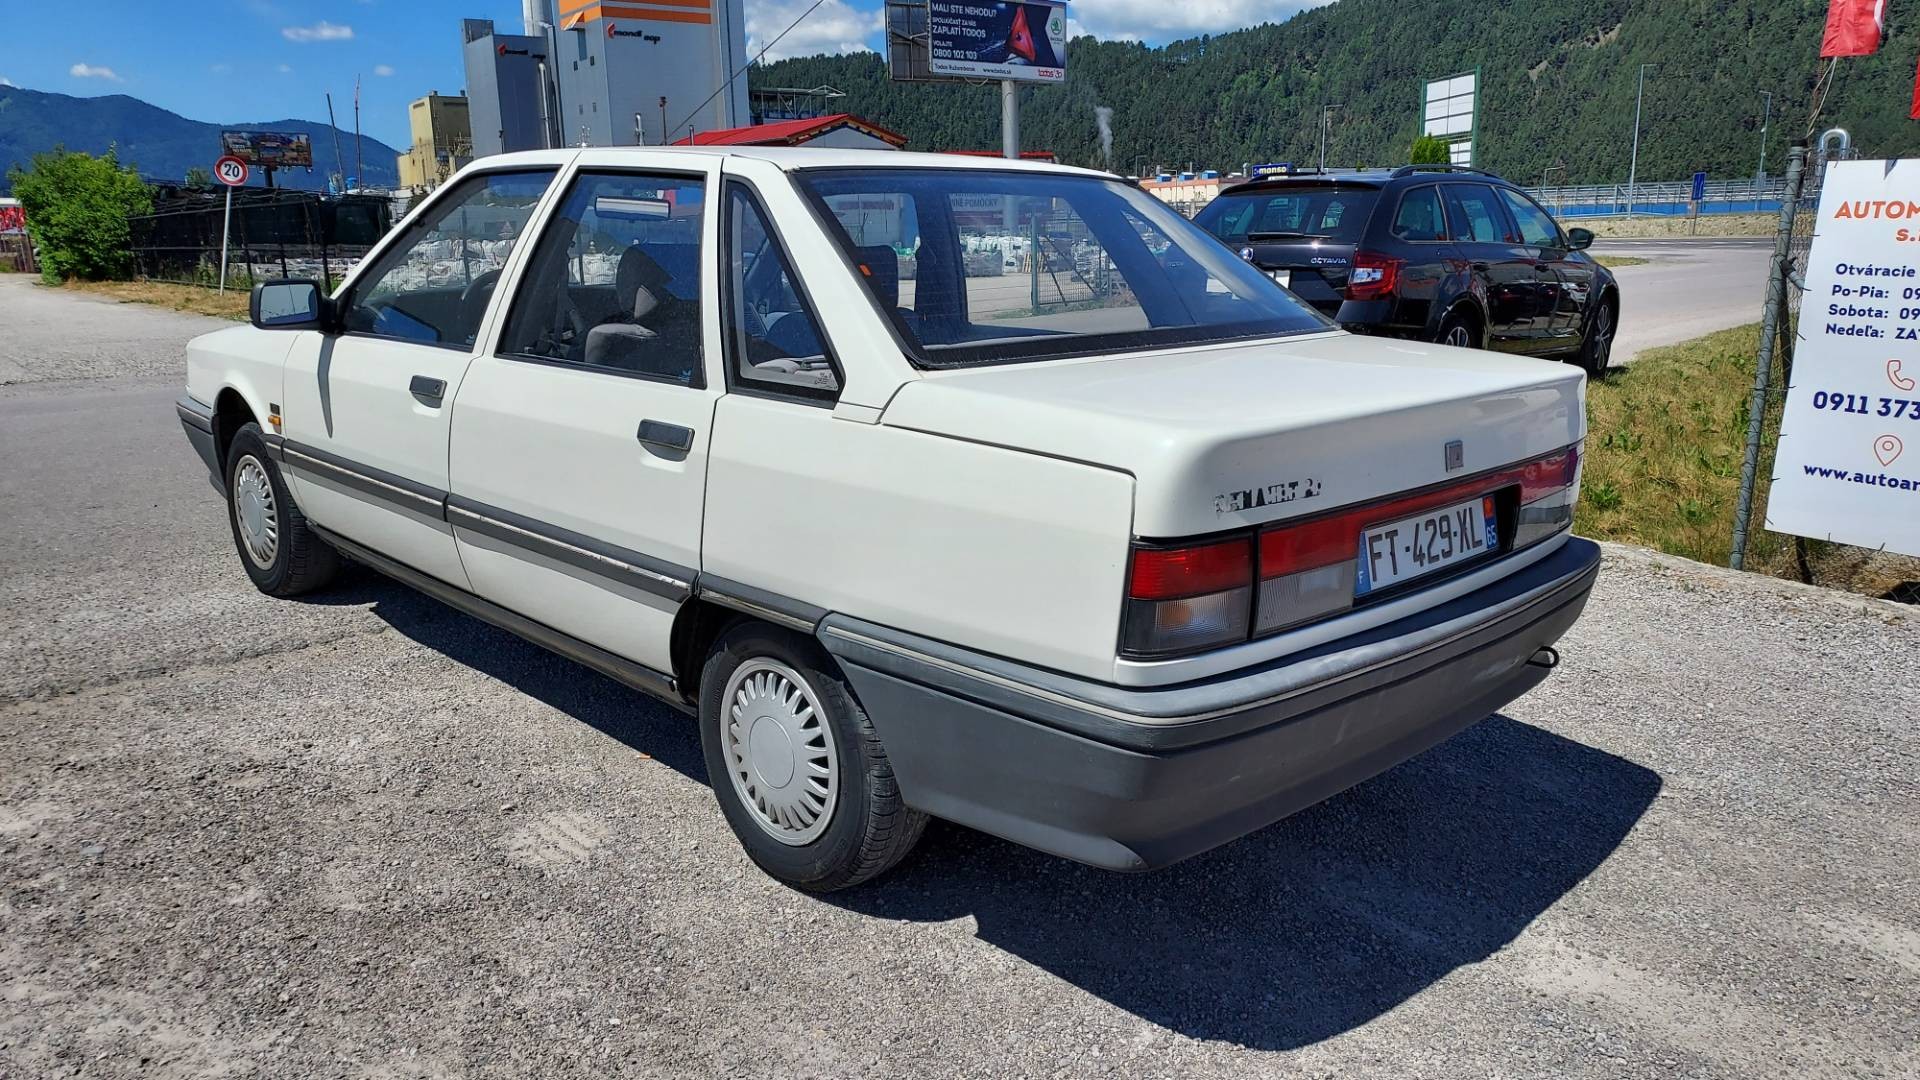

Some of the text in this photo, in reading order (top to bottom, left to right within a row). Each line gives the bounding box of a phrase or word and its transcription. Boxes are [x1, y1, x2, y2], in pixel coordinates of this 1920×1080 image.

[931, 3, 997, 18] MALI STE NEHODU?
[932, 25, 986, 39] ZAPLATÍ TODOS
[933, 49, 978, 60] 0800 102 103
[224, 163, 240, 178] 20
[1311, 257, 1347, 265] OCTAVIA
[1835, 263, 1916, 278] Otváracie
[1831, 284, 1889, 299] Po-Pia:
[1828, 303, 1920, 320] Sobota: 09
[1825, 322, 1885, 338] Nedeľa:
[1813, 391, 1920, 420] 0911 373
[1486, 524, 1497, 545] 65
[1367, 506, 1483, 583] FT-429-XL
[1358, 570, 1364, 585] F
